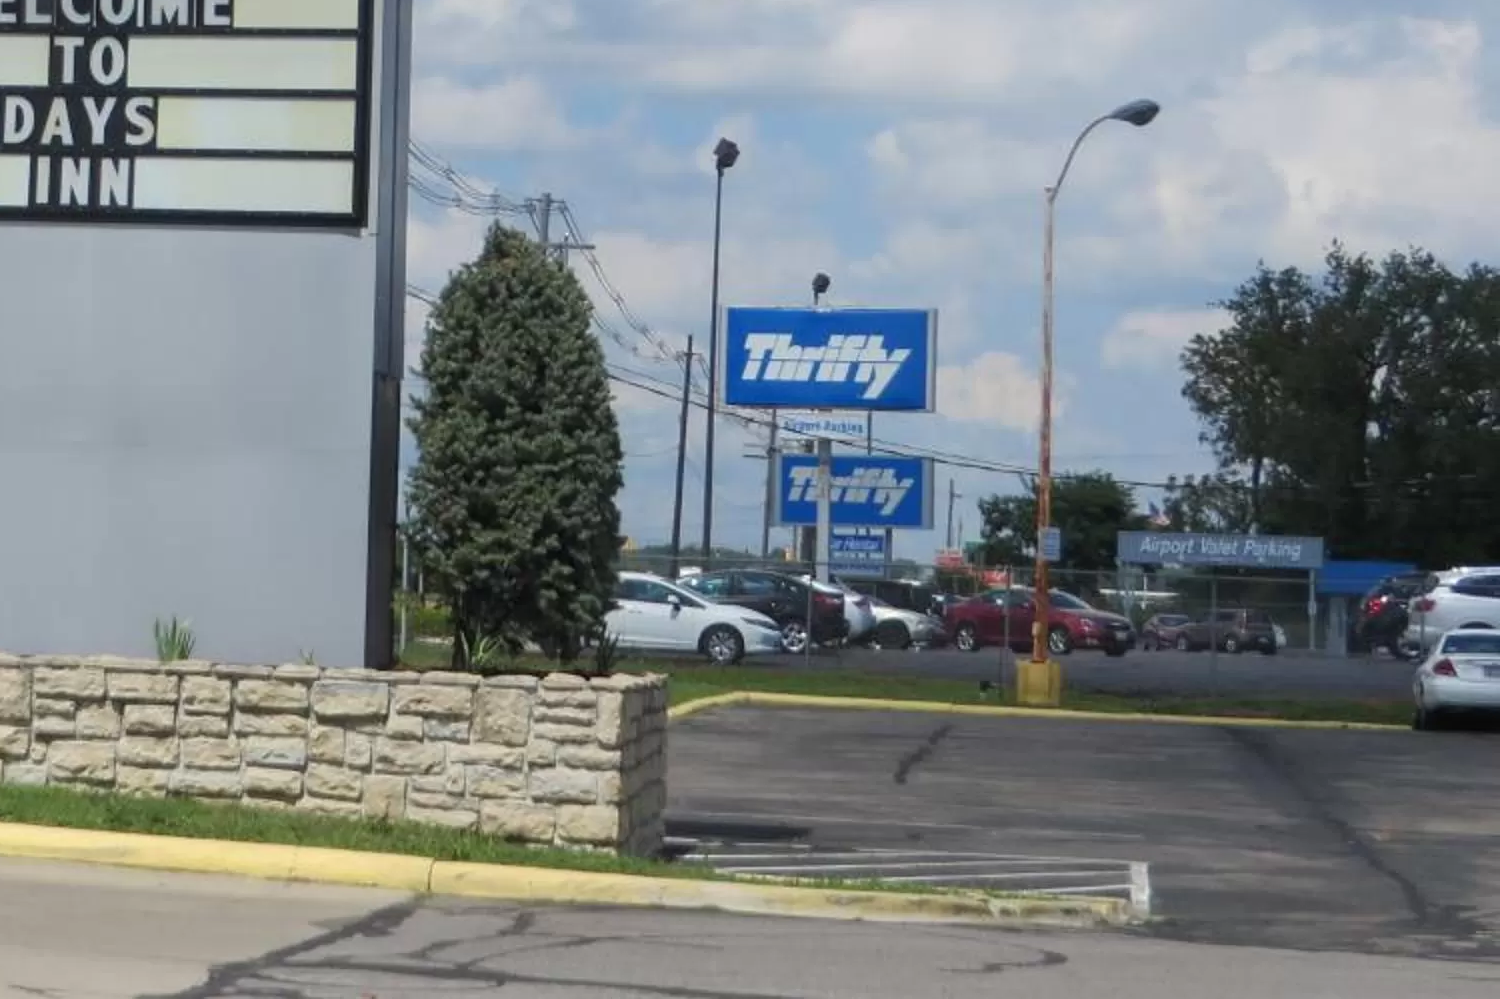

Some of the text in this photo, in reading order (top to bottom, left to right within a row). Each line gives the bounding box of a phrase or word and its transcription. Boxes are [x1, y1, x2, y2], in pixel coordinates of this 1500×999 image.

[53, 35, 126, 86] TO
[3, 95, 156, 147] DAYS
[34, 157, 130, 207] INN
[740, 332, 914, 400] Thrifty
[1139, 536, 1303, 561] Airport Valet Parking
